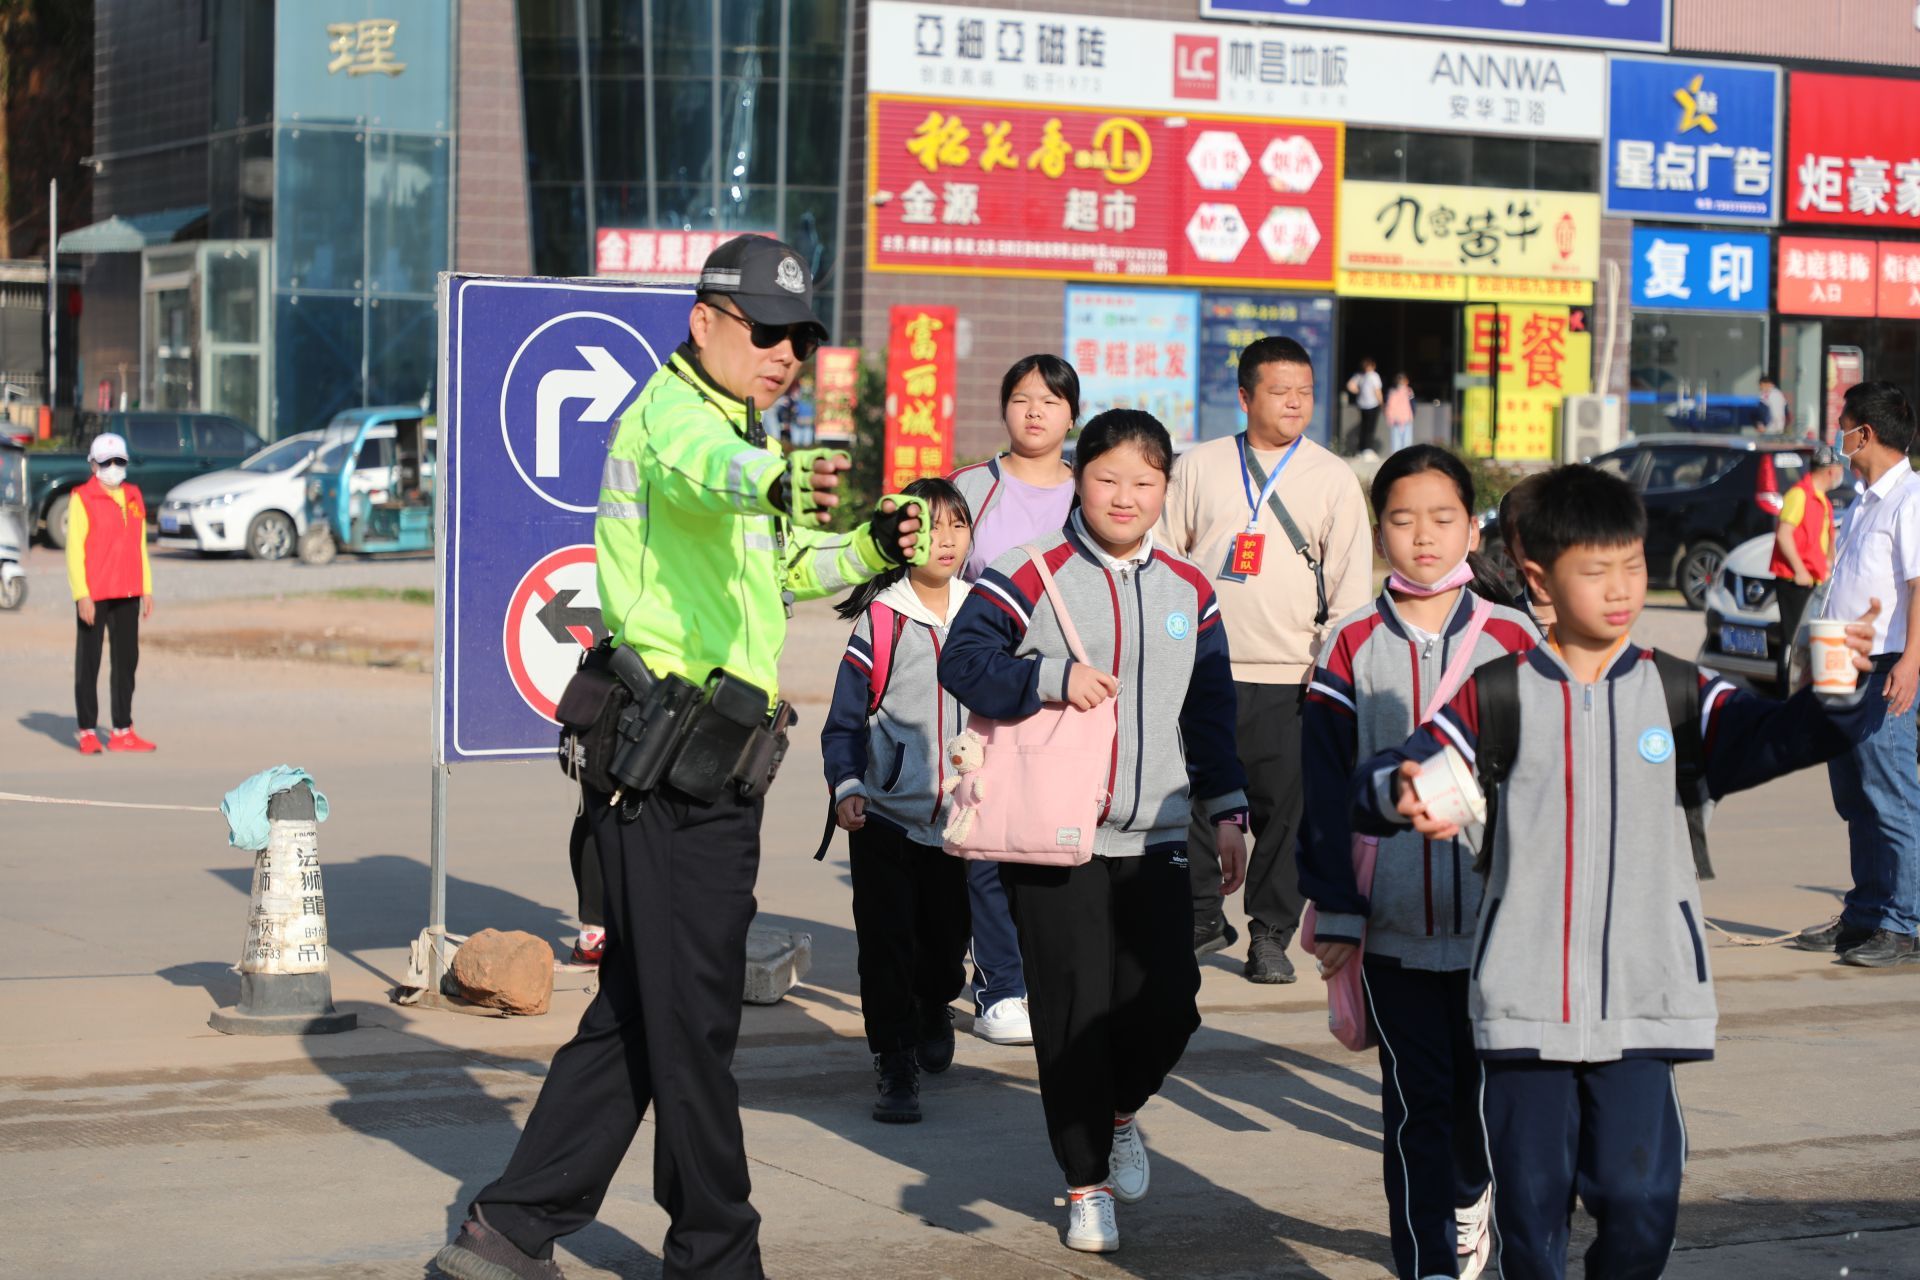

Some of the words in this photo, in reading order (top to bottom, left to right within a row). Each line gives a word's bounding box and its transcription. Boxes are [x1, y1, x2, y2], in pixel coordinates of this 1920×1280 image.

[326, 18, 407, 78] 理
[1229, 39, 1348, 88] 林昌地板
[1430, 51, 1567, 94] ANNWA
[1449, 95, 1546, 125] 安华卫浴
[1615, 139, 1772, 197] 星点广告
[1797, 153, 1920, 218] 炬豪家
[900, 180, 981, 226] 金源
[1062, 187, 1138, 233] 超市
[1644, 238, 1754, 301] 复印
[1808, 283, 1842, 304] 入口
[1074, 338, 1188, 379] 雪糕批发
[1467, 311, 1566, 389] 早餐
[1240, 540, 1257, 570] 护校队
